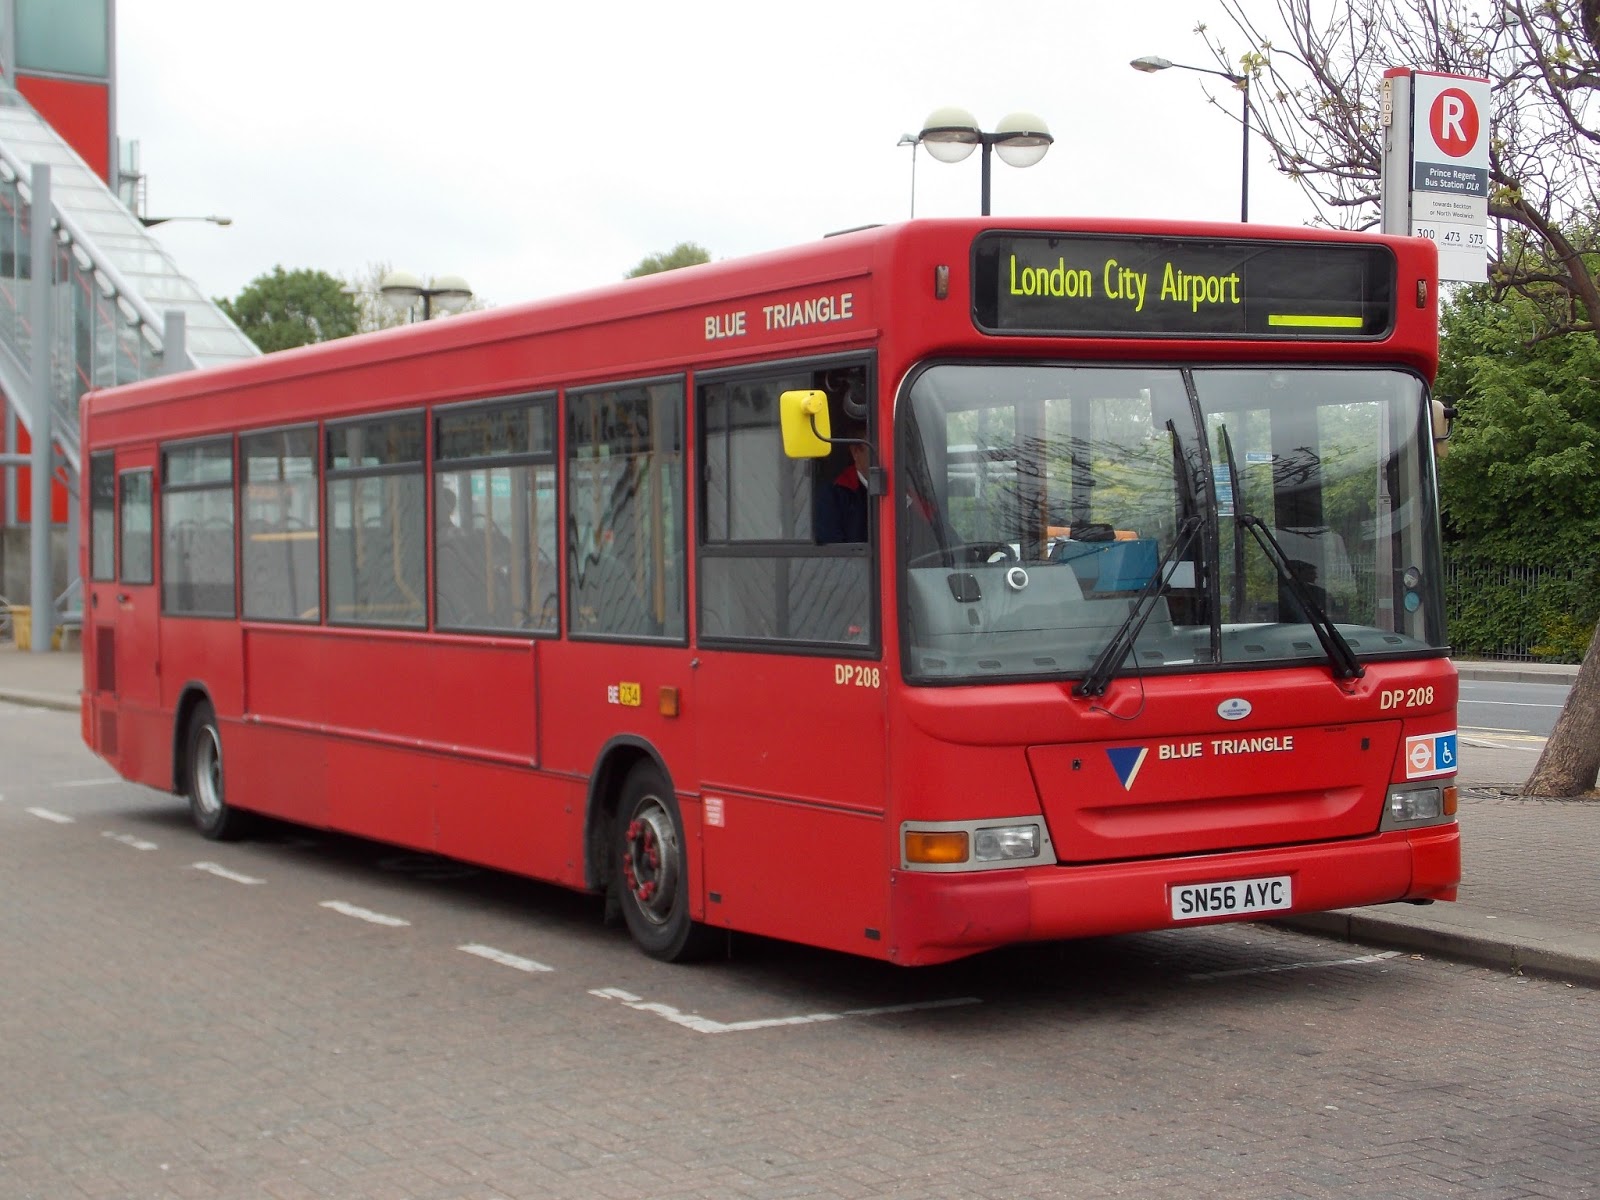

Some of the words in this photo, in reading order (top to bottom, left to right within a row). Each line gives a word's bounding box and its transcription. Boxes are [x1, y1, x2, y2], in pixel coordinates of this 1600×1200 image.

[1442, 95, 1467, 141] R
[1425, 178, 1438, 187] Bus
[1440, 179, 1464, 189] Station
[1466, 182, 1480, 191] DLR
[1430, 168, 1451, 177] Prince
[1453, 171, 1476, 181] Regent
[1417, 229, 1434, 239] 300
[1445, 232, 1460, 241] 473
[1469, 234, 1483, 244] 573
[1009, 254, 1092, 298] London
[1103, 258, 1147, 313] City
[1160, 262, 1240, 313] Airport
[705, 311, 746, 340] BLUE
[763, 293, 853, 331] TRIANGLE
[835, 664, 854, 685] DP
[855, 667, 880, 688] 208
[1380, 689, 1404, 710] DP
[1406, 686, 1434, 708] 208
[1158, 742, 1203, 761] BLUE
[1211, 736, 1294, 755] TRIANGLE
[1180, 885, 1236, 914] SN56
[1244, 881, 1283, 908] AYC
